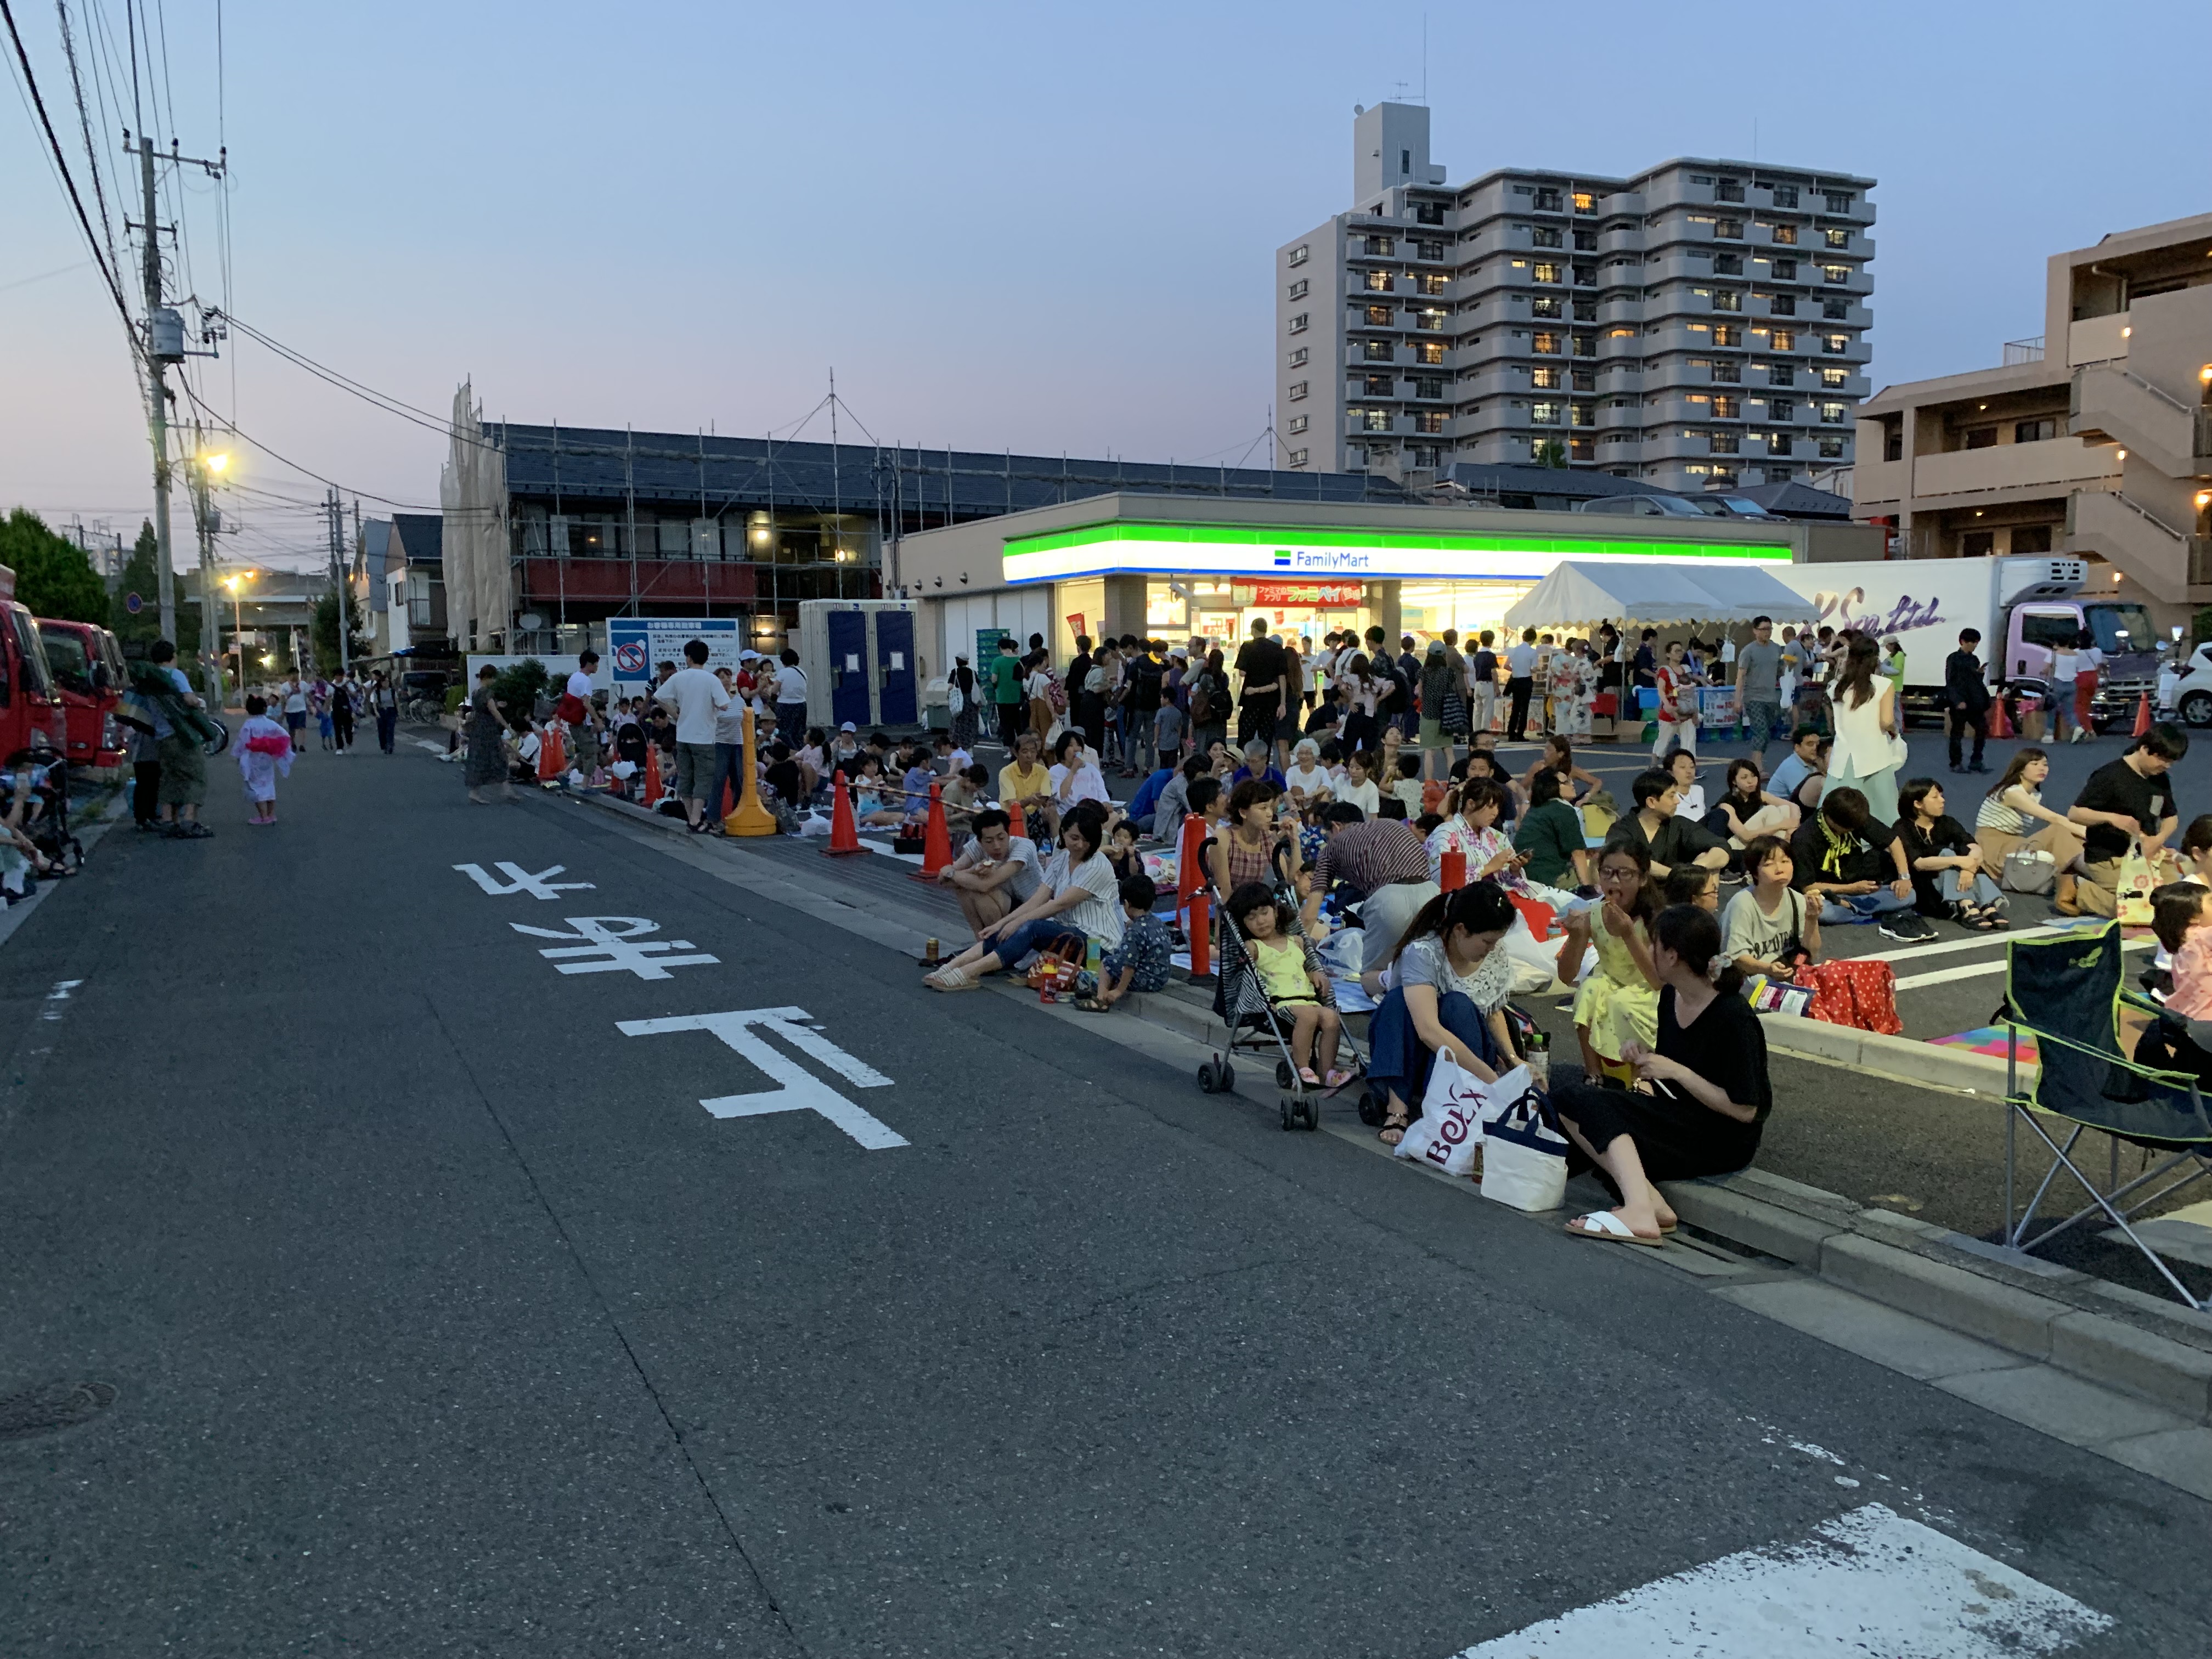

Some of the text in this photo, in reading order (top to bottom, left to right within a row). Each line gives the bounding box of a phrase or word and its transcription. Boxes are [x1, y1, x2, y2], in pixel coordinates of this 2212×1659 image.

[1297, 551, 1369, 569] FamilyMart
[1287, 585, 1342, 602] ファミペイ
[452, 861, 911, 1150] 止まれ
